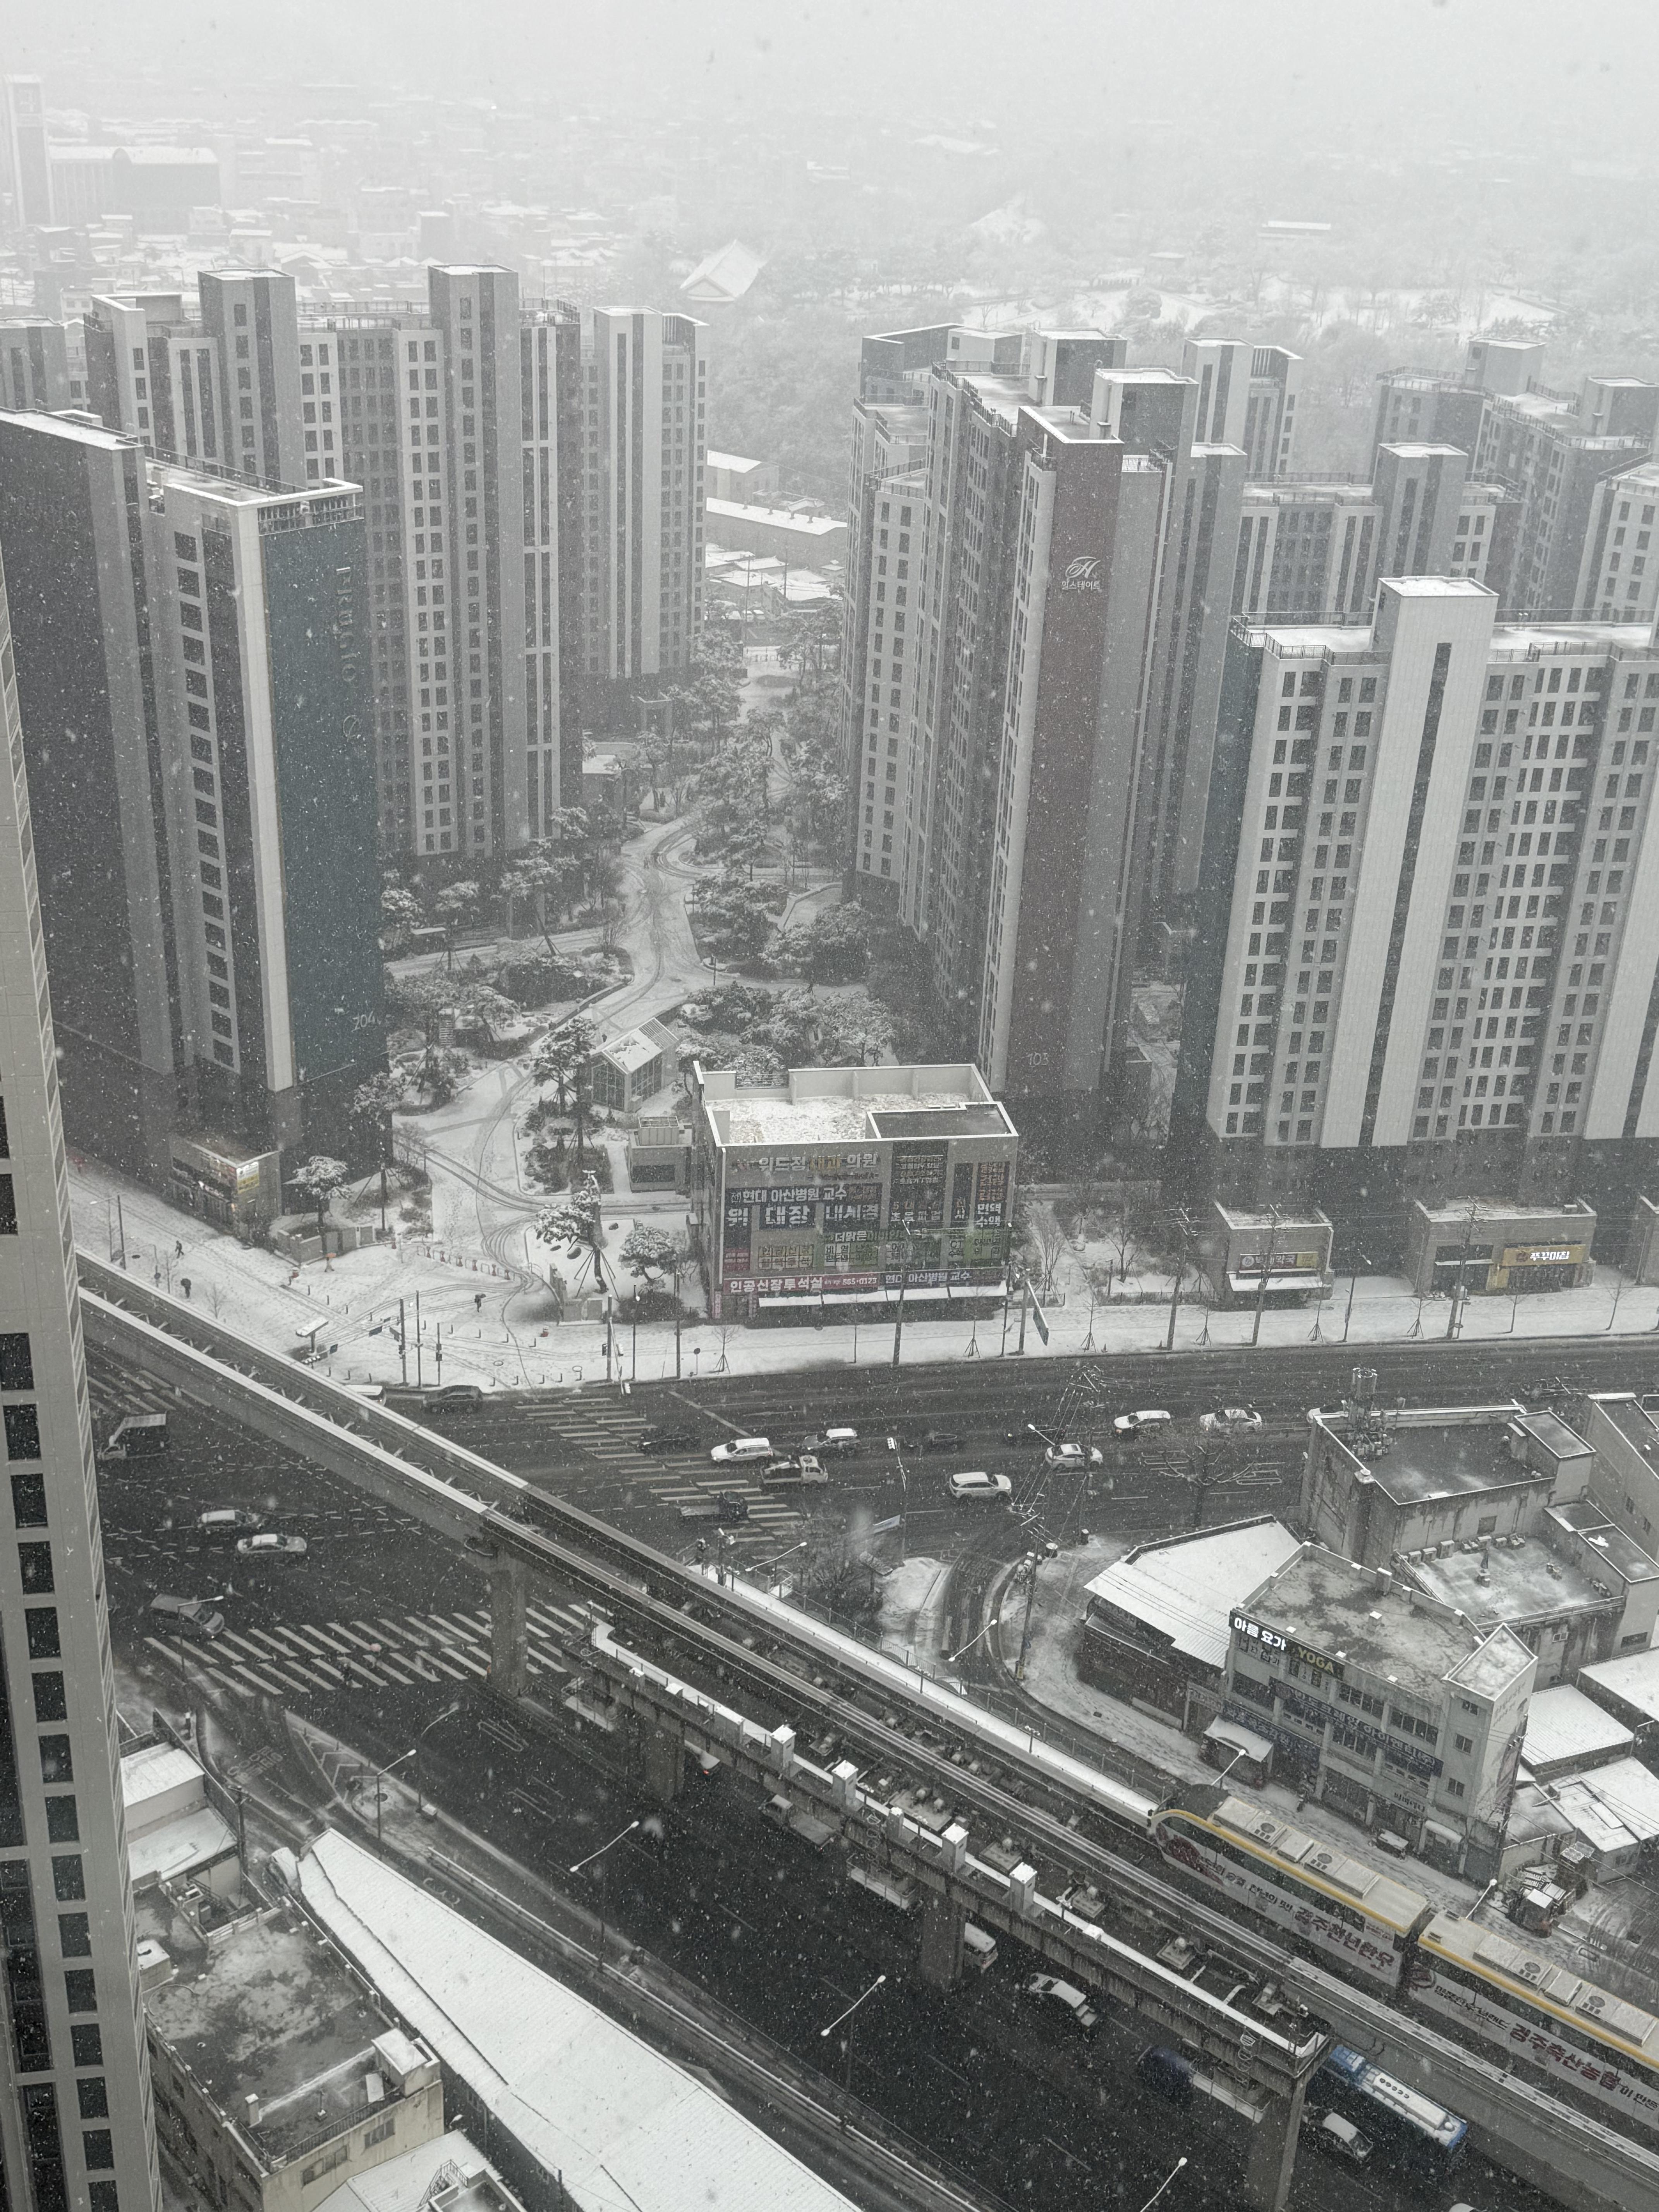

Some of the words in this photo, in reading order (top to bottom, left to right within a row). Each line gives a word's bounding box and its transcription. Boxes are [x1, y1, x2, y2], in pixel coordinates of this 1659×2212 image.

[759, 1156, 806, 1171] 위드정
[809, 1155, 841, 1171] 내과
[846, 1152, 878, 1168] 의원
[771, 1187, 820, 1202] 아산병원
[823, 1185, 847, 1200] 교수
[725, 1207, 749, 1227] 위
[765, 1205, 810, 1224] 대장
[825, 1204, 879, 1221] 내시경
[977, 1202, 1001, 1215] 면역
[975, 1215, 1001, 1228] 수액
[730, 1277, 823, 1293] 인공신장투석실
[908, 1272, 948, 1283] 아산병원
[950, 1271, 972, 1281] 교수
[1234, 1617, 1259, 1638] 아름
[1261, 1630, 1288, 1650] 요가
[1297, 1646, 1334, 1674] YOGA
